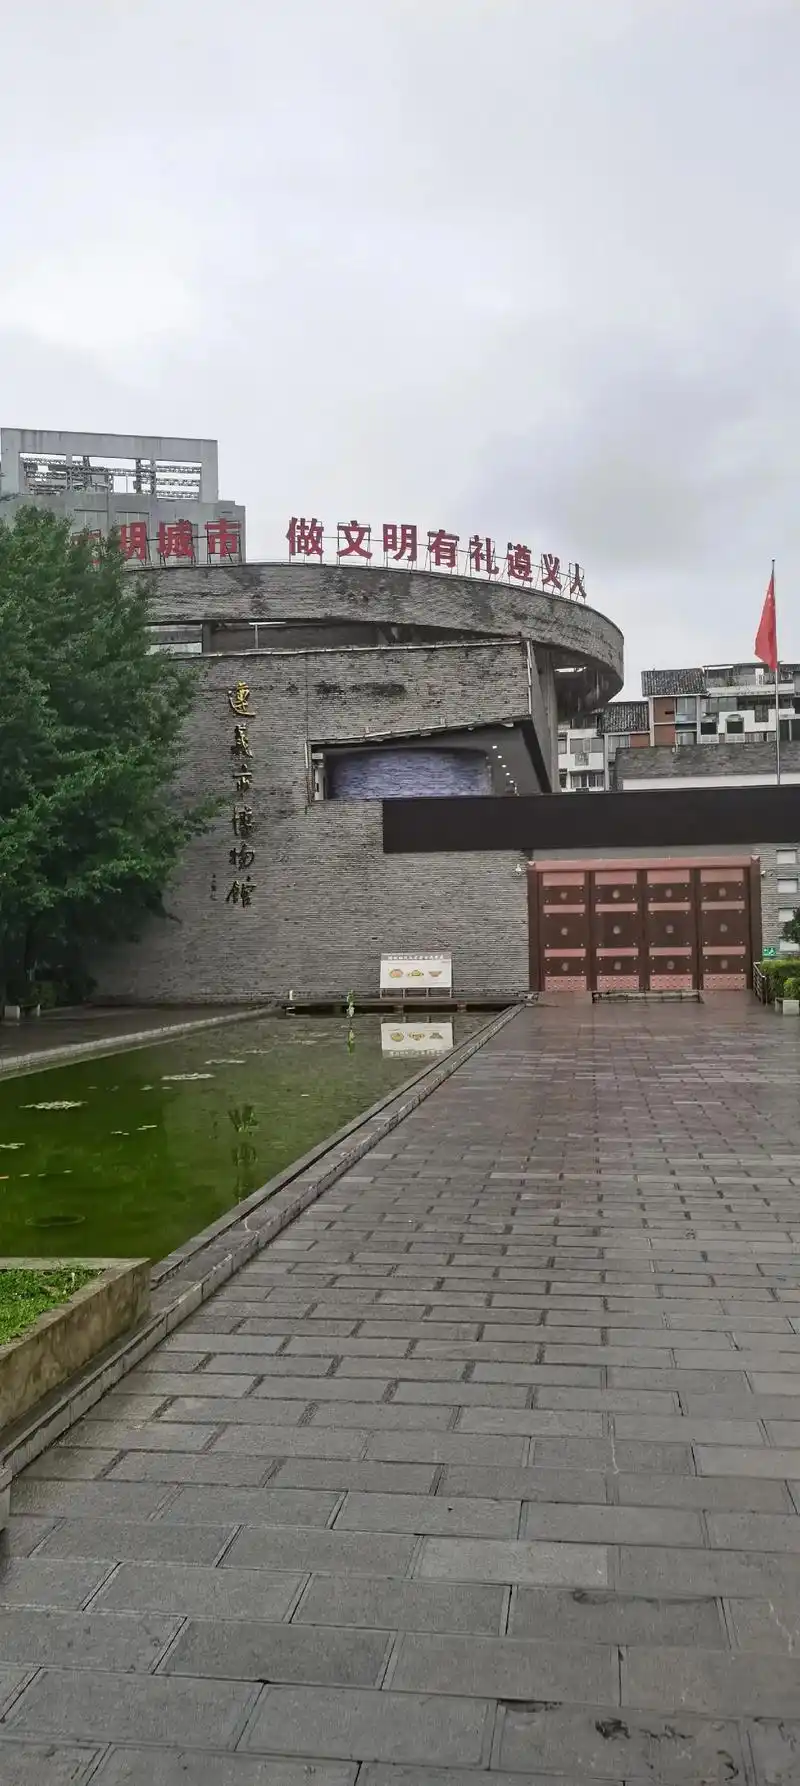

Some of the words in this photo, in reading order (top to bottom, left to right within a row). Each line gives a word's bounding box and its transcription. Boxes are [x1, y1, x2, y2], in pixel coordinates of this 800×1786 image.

[71, 517, 241, 564] 明城市
[286, 516, 587, 599] 做文明有礼遵义人
